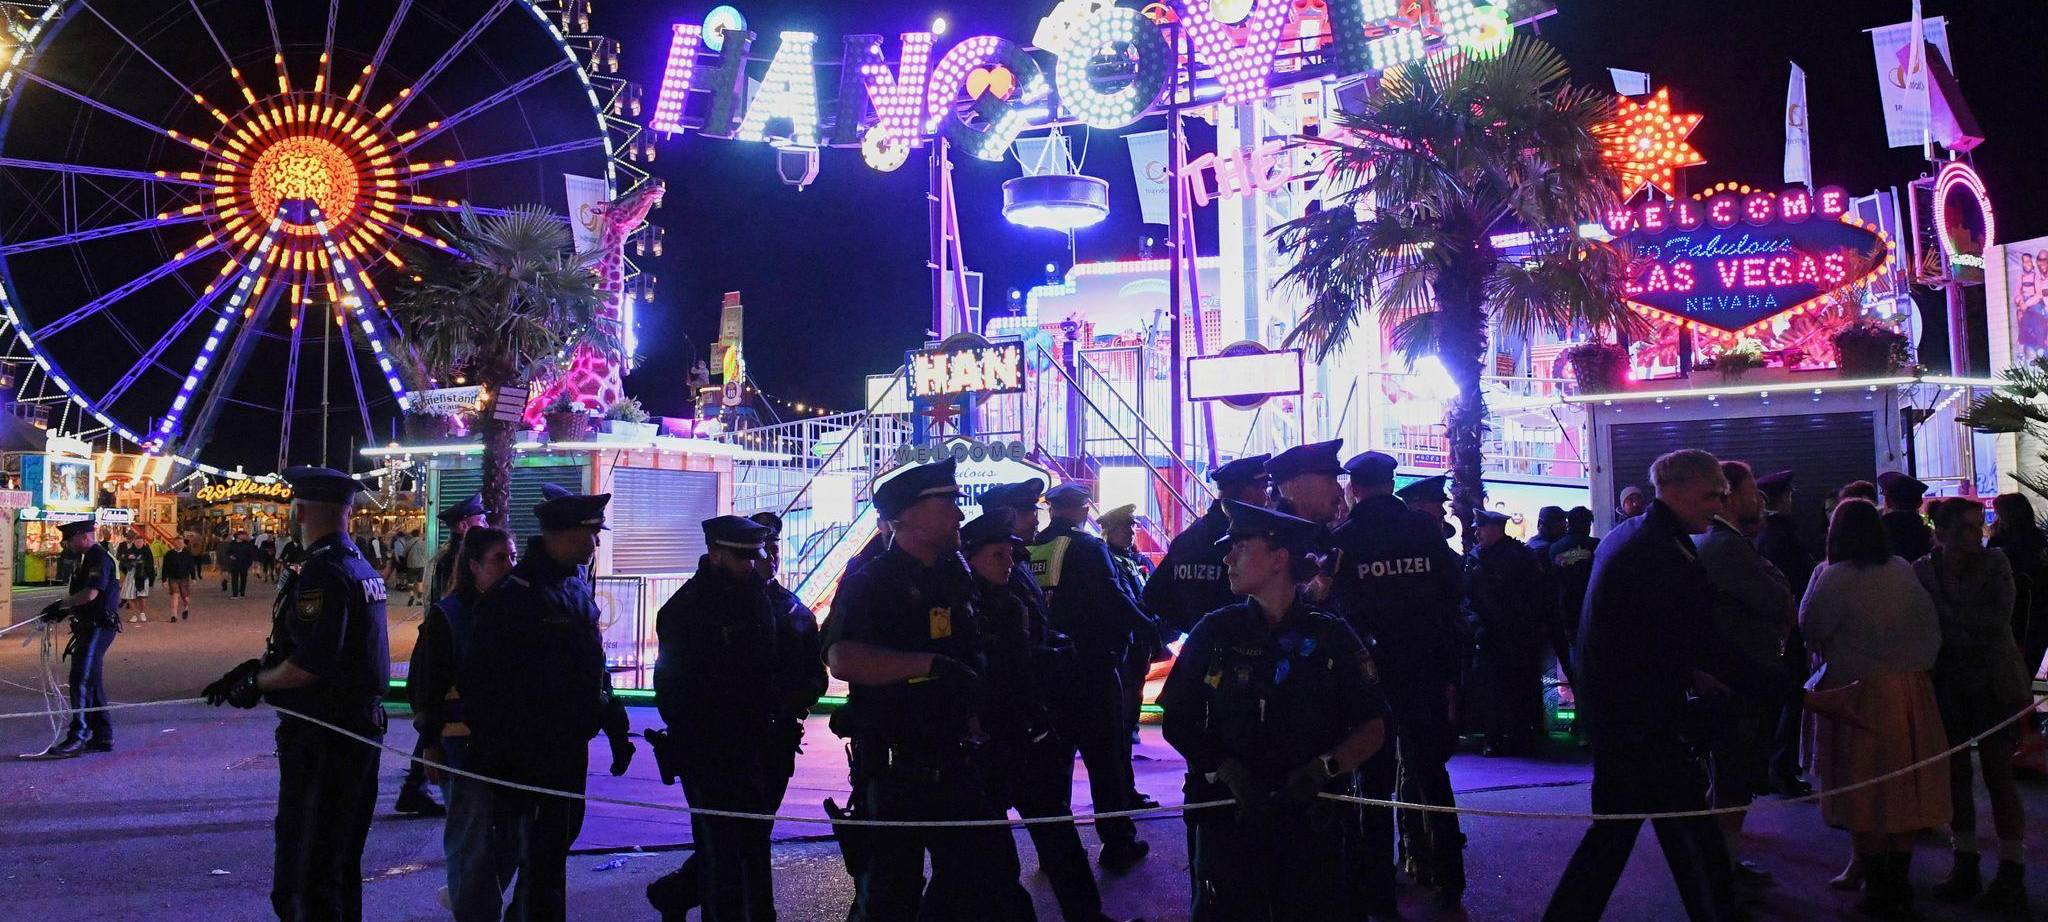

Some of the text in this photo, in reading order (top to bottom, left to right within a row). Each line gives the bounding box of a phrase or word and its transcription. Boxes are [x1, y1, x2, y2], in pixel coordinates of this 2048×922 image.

[1178, 140, 1292, 207] THE
[1607, 191, 1842, 231] WELCOME
[1665, 233, 1792, 264] Fabulous
[1625, 252, 1847, 293] LAS VEGAS
[1686, 293, 1778, 312] NEVADA
[915, 345, 1020, 396] HAN
[899, 445, 1021, 461] WELCOME
[1173, 563, 1222, 581] POLIZEI
[1357, 557, 1431, 579] POLIZEI
